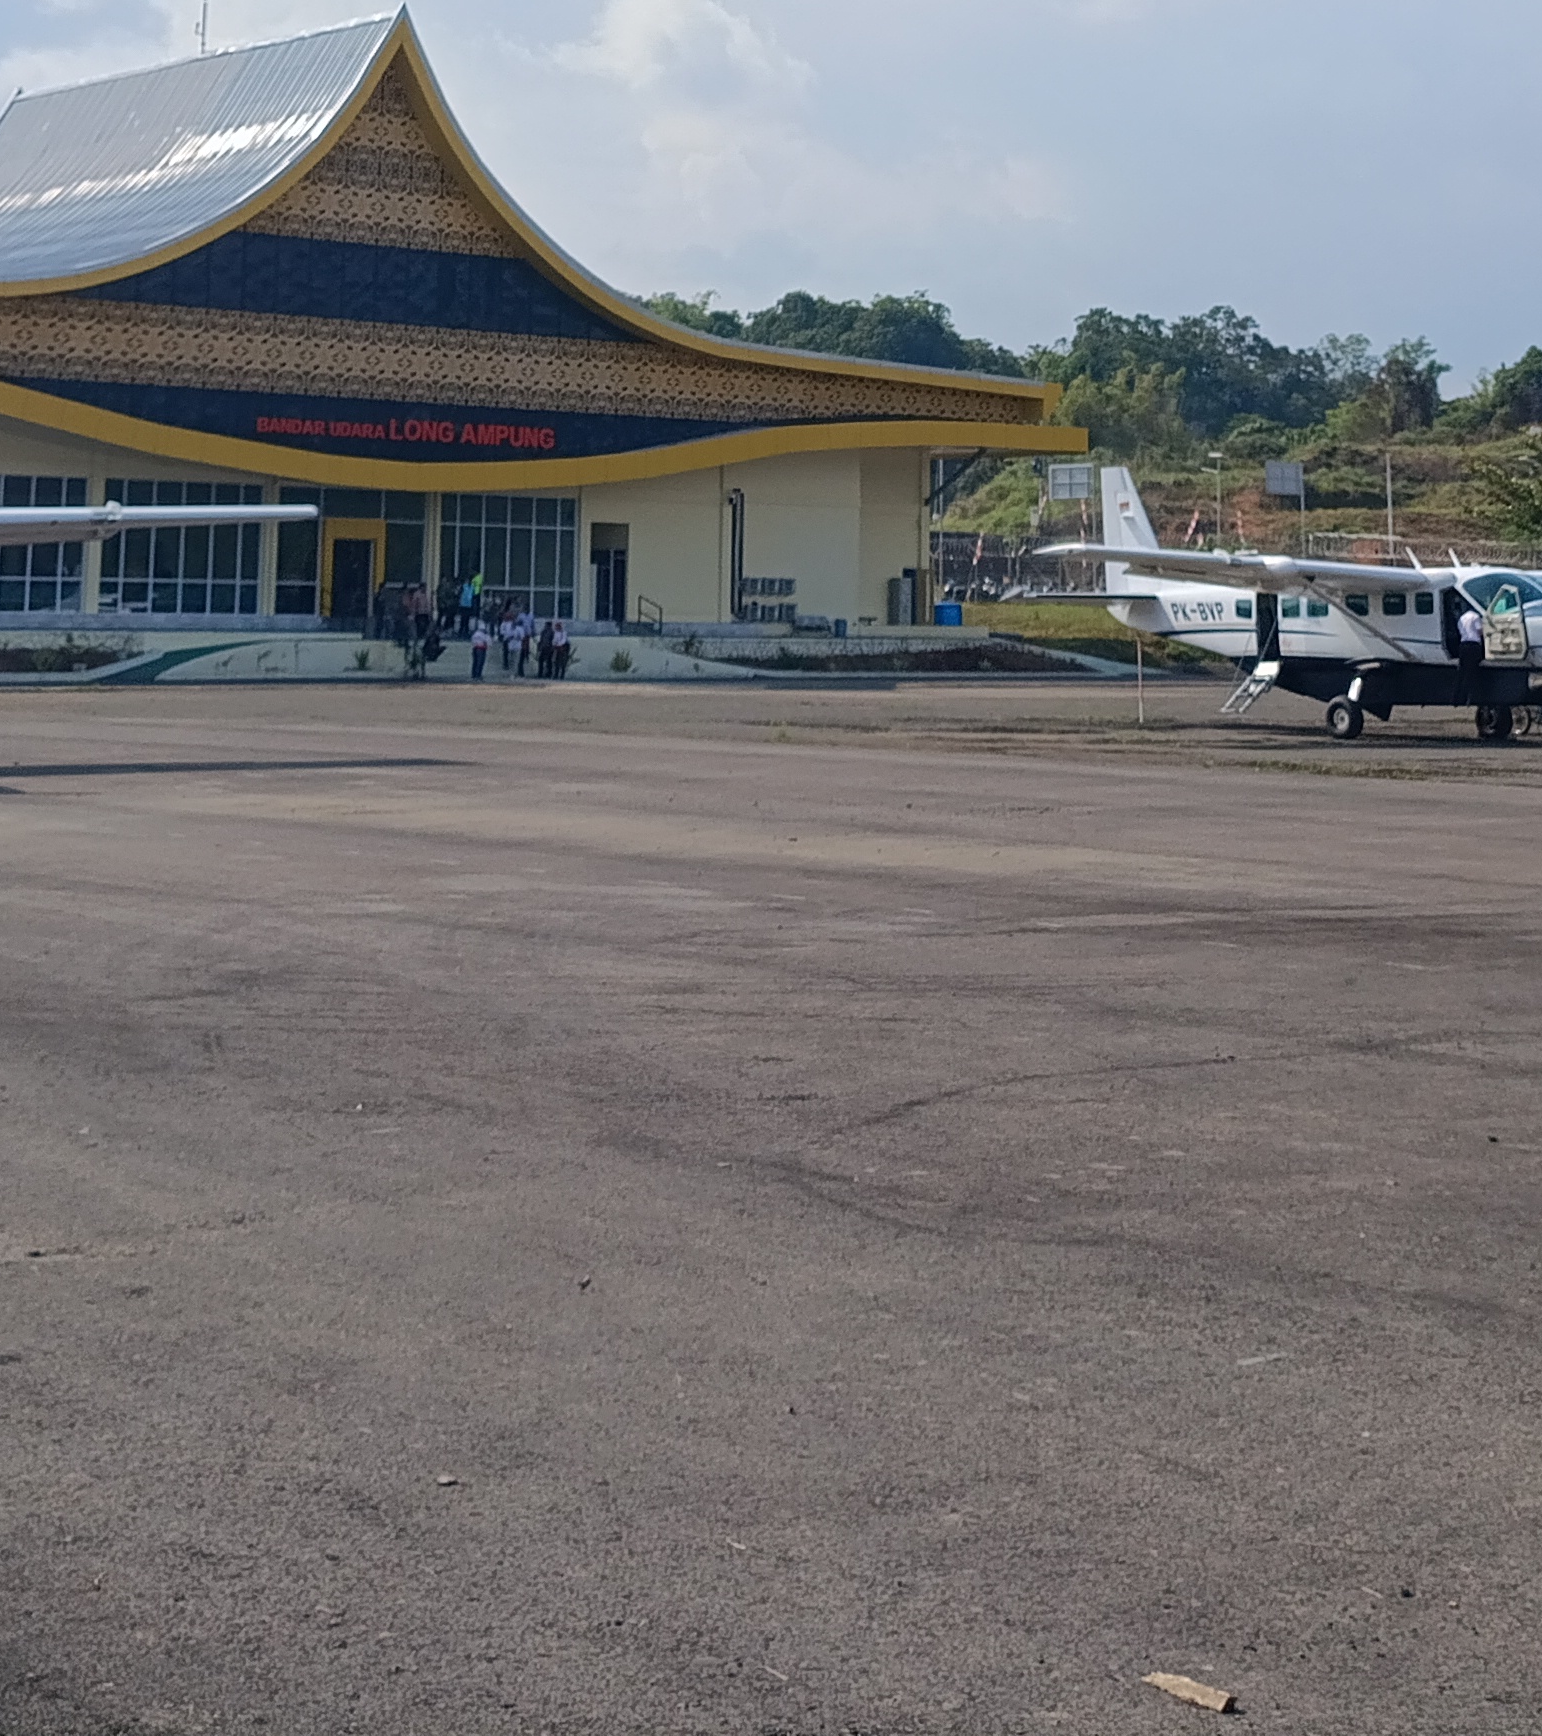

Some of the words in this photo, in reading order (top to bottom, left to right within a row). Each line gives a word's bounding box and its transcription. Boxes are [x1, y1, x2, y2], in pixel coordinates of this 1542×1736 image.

[256, 415, 326, 437] BANDAR
[328, 420, 386, 440] UDARA
[388, 417, 455, 443] LONG
[460, 423, 556, 450] AMPUNG
[1170, 602, 1224, 622] PK-BVP
